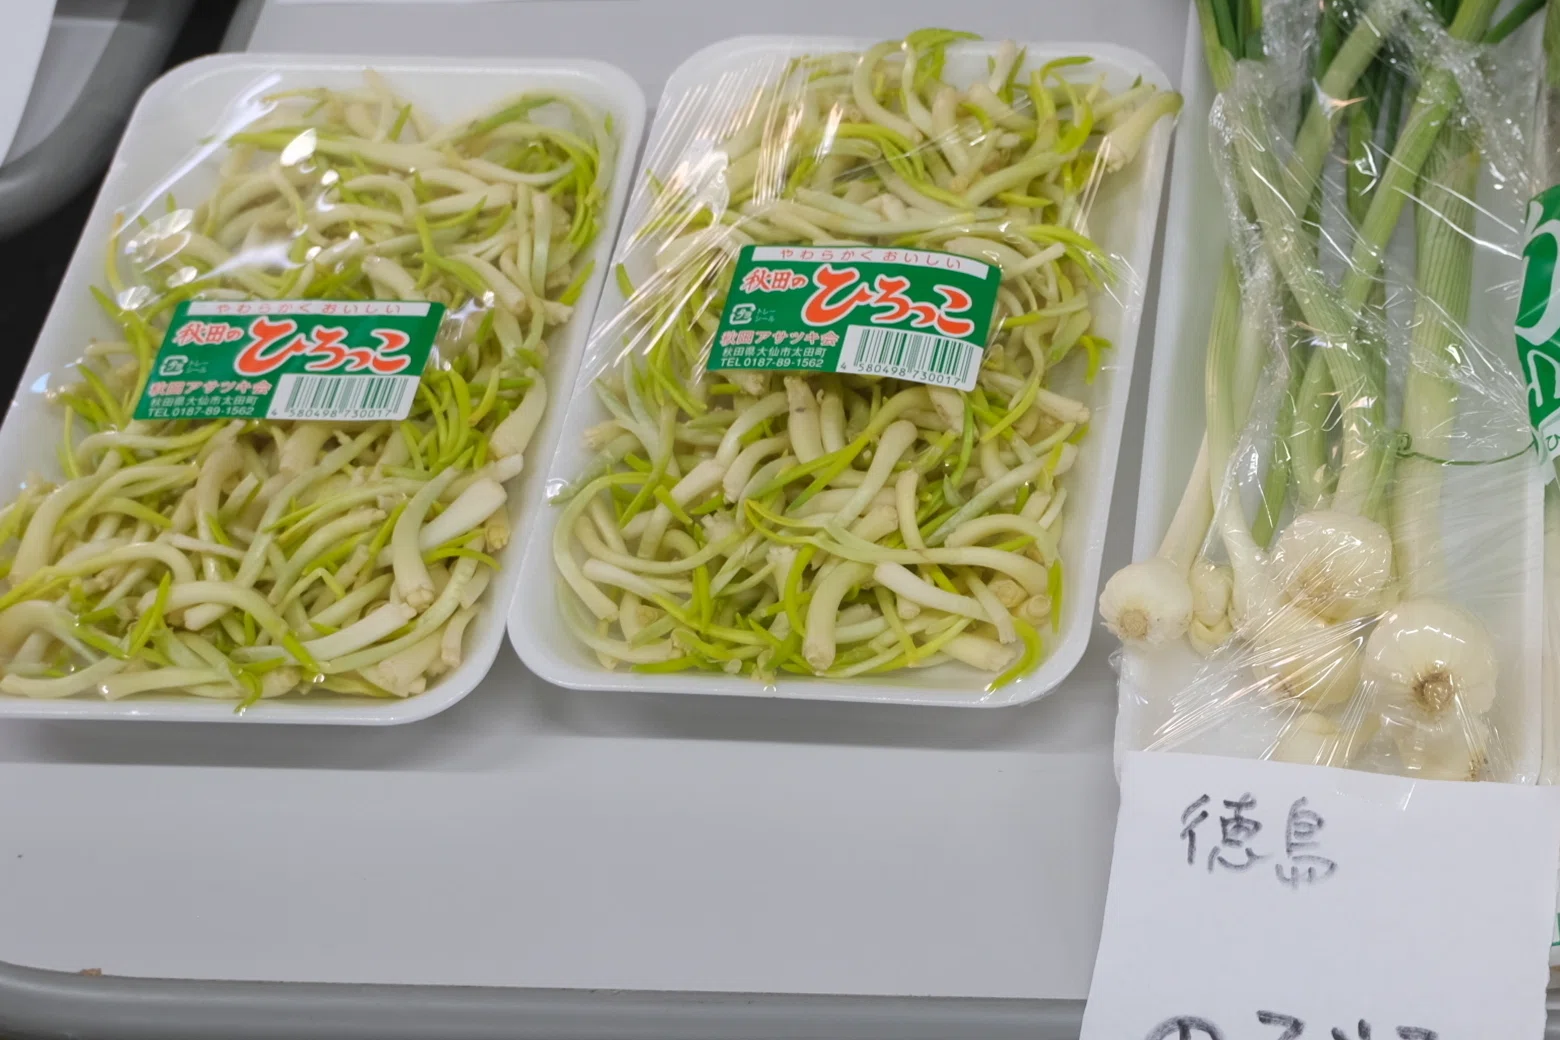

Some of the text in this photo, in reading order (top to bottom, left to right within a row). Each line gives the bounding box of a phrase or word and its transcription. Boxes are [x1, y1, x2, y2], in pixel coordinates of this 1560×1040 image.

[738, 263, 976, 339] 秋田の ひろっこ
[172, 314, 412, 376] 秋田の ひろっこ
[720, 329, 840, 348] 秋田アサツキ会
[722, 346, 828, 359] 秋田県大仙市太田町
[743, 358, 825, 368] 0187-89-1562
[1179, 791, 1339, 891] 徳島
